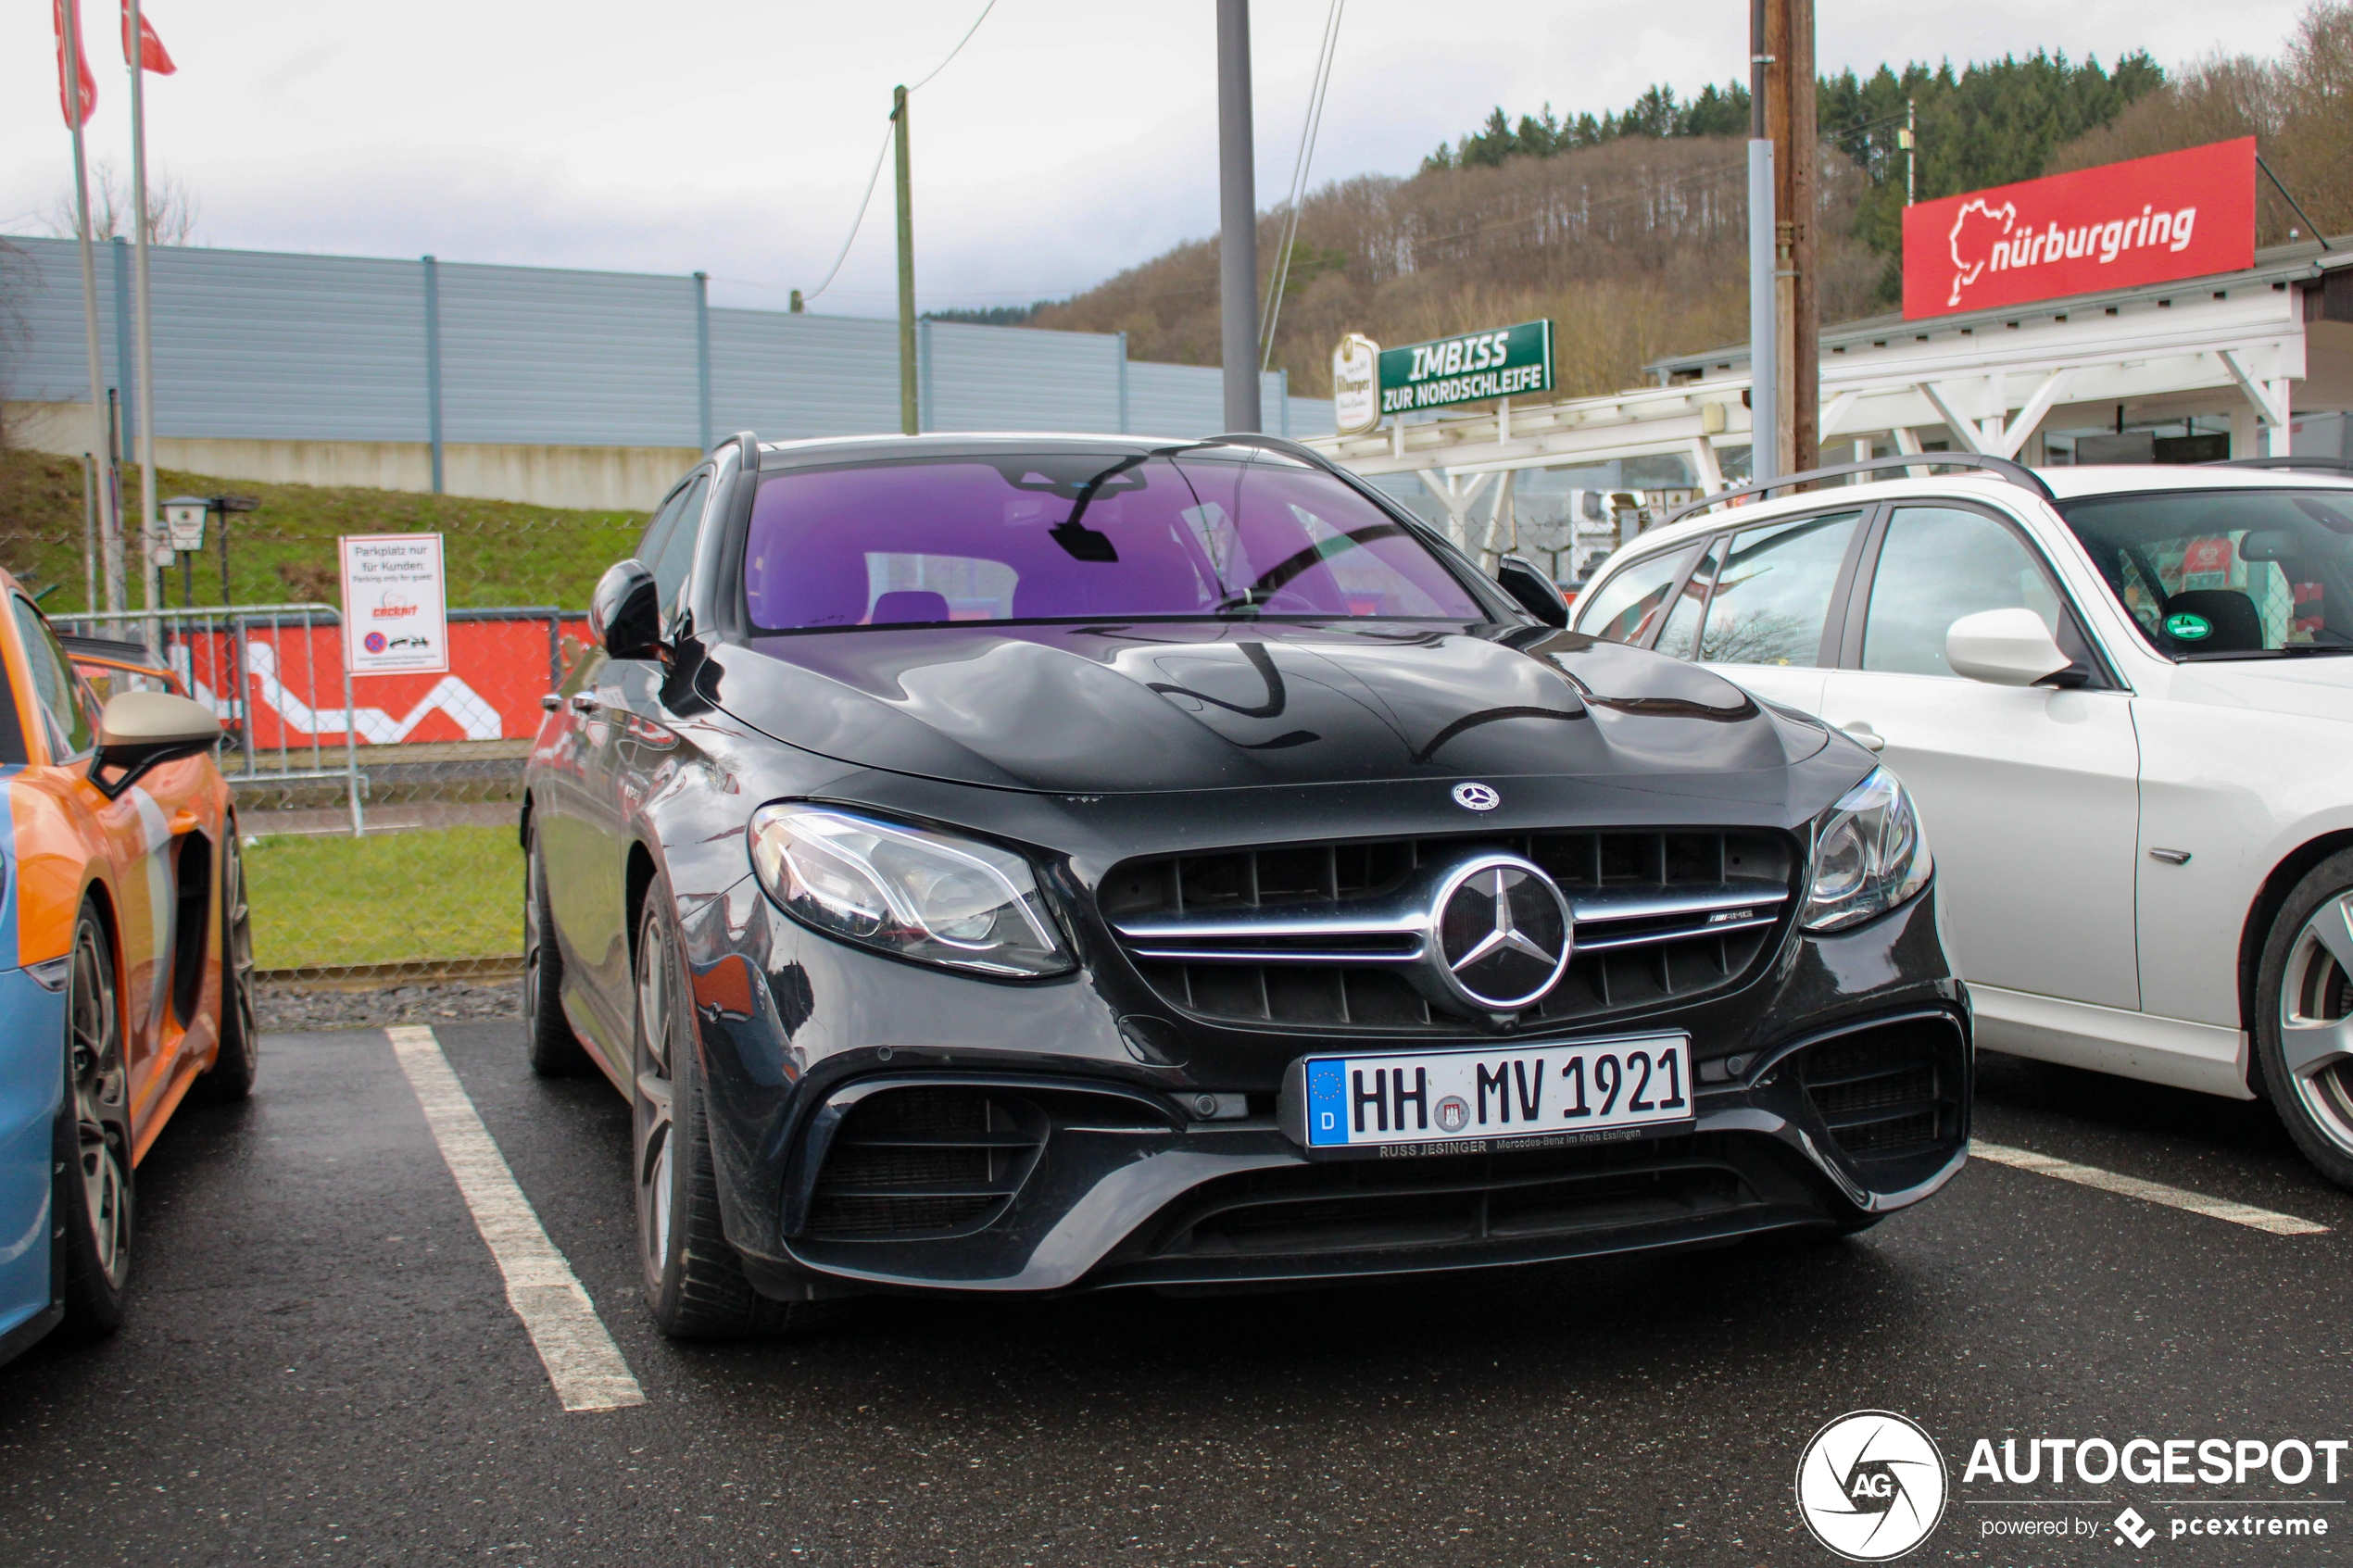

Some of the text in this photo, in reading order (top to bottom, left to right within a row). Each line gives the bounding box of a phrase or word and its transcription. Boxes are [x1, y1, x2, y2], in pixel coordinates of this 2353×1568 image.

[1990, 204, 2196, 272] nürburgring
[1407, 331, 1510, 382] IMBISS
[1383, 365, 1542, 412] ZUR NORDSCHLEIFE
[355, 546, 428, 558] Parkplatz nur
[353, 575, 382, 583] Parking
[362, 562, 378, 572] für
[2180, 616, 2192, 626] 4
[1353, 1066, 1428, 1132] HH
[1477, 1058, 1545, 1124] MV
[1562, 1047, 1686, 1118] 1921
[1321, 1111, 1335, 1130] D
[1379, 1129, 1642, 1158] RUSS JESINGER Mercedes-Benz im Kreis Esslingen
